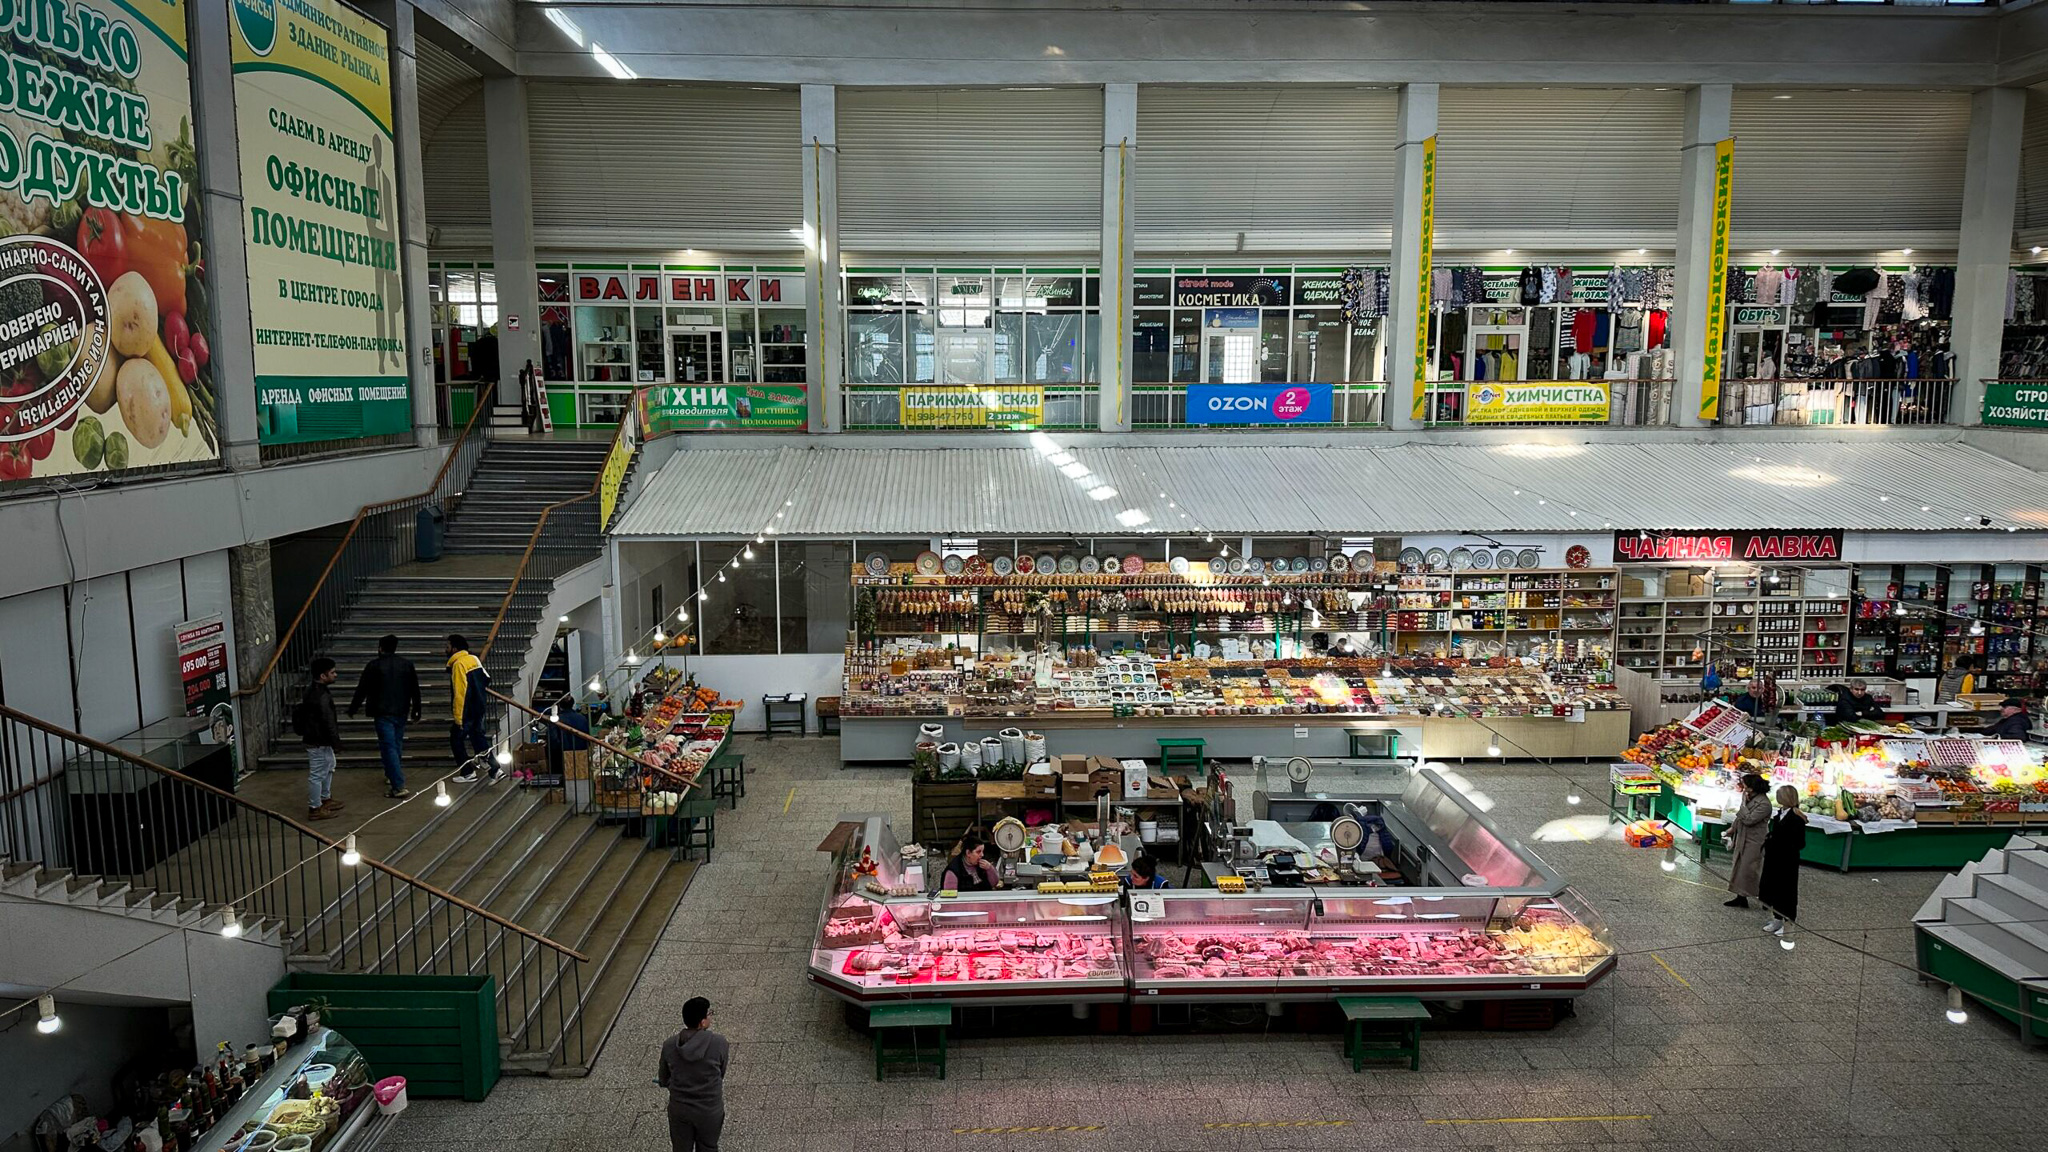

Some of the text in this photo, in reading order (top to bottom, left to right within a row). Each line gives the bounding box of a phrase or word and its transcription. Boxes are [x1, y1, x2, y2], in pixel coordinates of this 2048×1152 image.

[288, 22, 381, 86] ЗДАНИЕ РЫНКА
[268, 107, 372, 164] СДАЕМ В АРЕНДУ
[267, 154, 381, 220] ОФИСНЫЕ
[250, 206, 397, 271] ПОМЕЩЕНИЯ
[1703, 152, 1731, 383] Мальцевский
[278, 278, 384, 311] В ЦЕНТРЕ ГОРОДА
[578, 276, 782, 302] ВАЛЕНКИ
[1303, 290, 1340, 302] ОДЕЖДА
[1485, 290, 1512, 299] БЕЛЬЕ
[1178, 293, 1260, 306] КОСМЕТИКА
[261, 383, 407, 405] АРЕНДА ОФИСНЫХ ПОМЕЩЕНИЙ
[907, 394, 1039, 406] ПАРИКМАХРСКАЯ
[1285, 391, 1296, 404] 2
[1506, 389, 1604, 403] ХИМЧИСТКА
[1208, 397, 1267, 411] OZON
[1278, 405, 1303, 413] этаж
[754, 407, 799, 416] ЛЕСТНИЦЫ
[988, 412, 1020, 421] 2 этаж
[741, 418, 803, 426] ПОДОКОННИКИ
[1618, 531, 1837, 559] ЧАЙНАЯ ЛАВКА
[182, 660, 195, 673] 695
